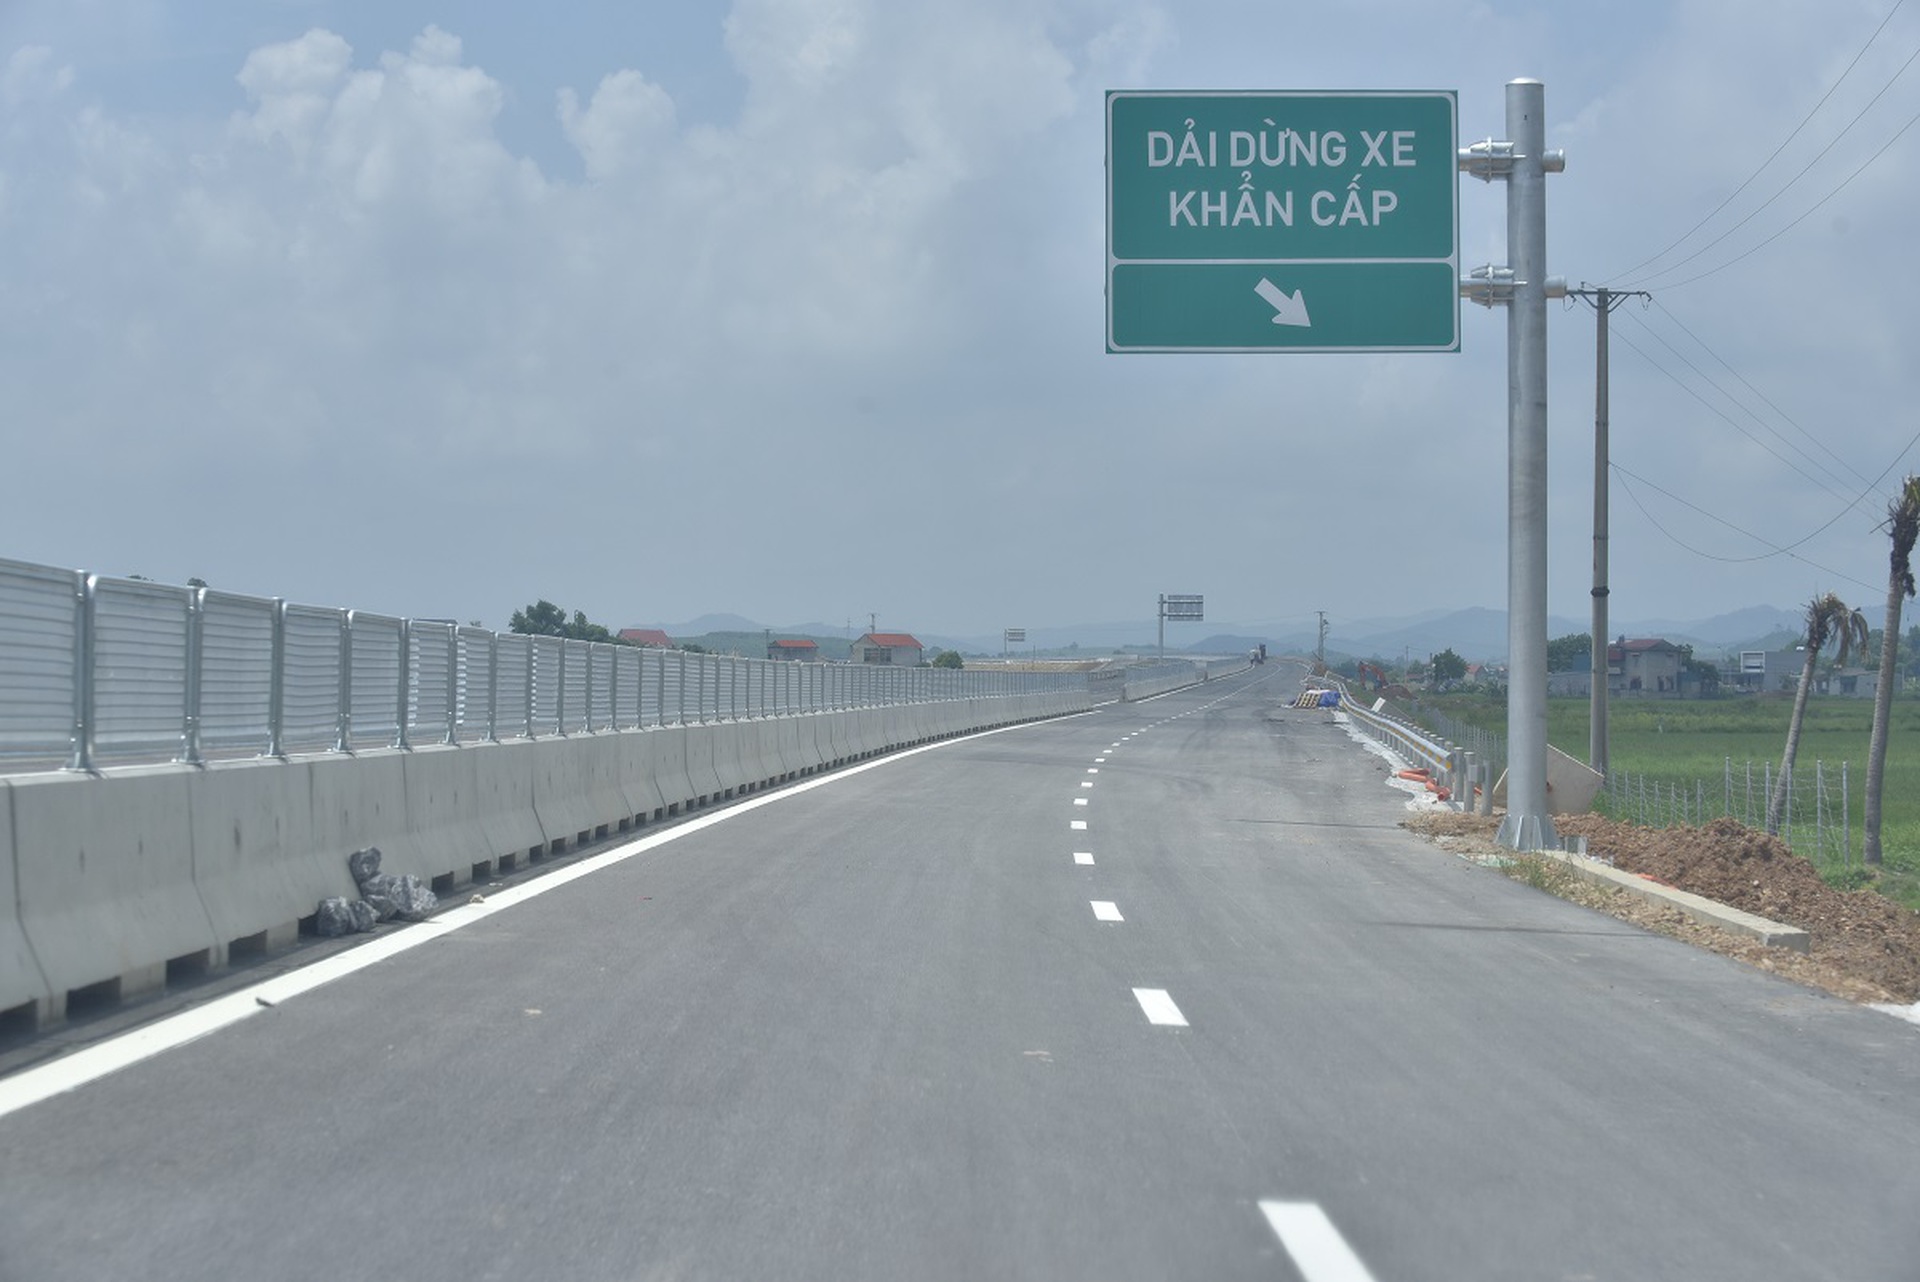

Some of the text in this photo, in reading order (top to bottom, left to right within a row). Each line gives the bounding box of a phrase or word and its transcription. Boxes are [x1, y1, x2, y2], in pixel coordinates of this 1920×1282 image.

[1148, 118, 1416, 167] DẢI DỪNG XE
[1169, 171, 1398, 226] KHẨN CẤP
